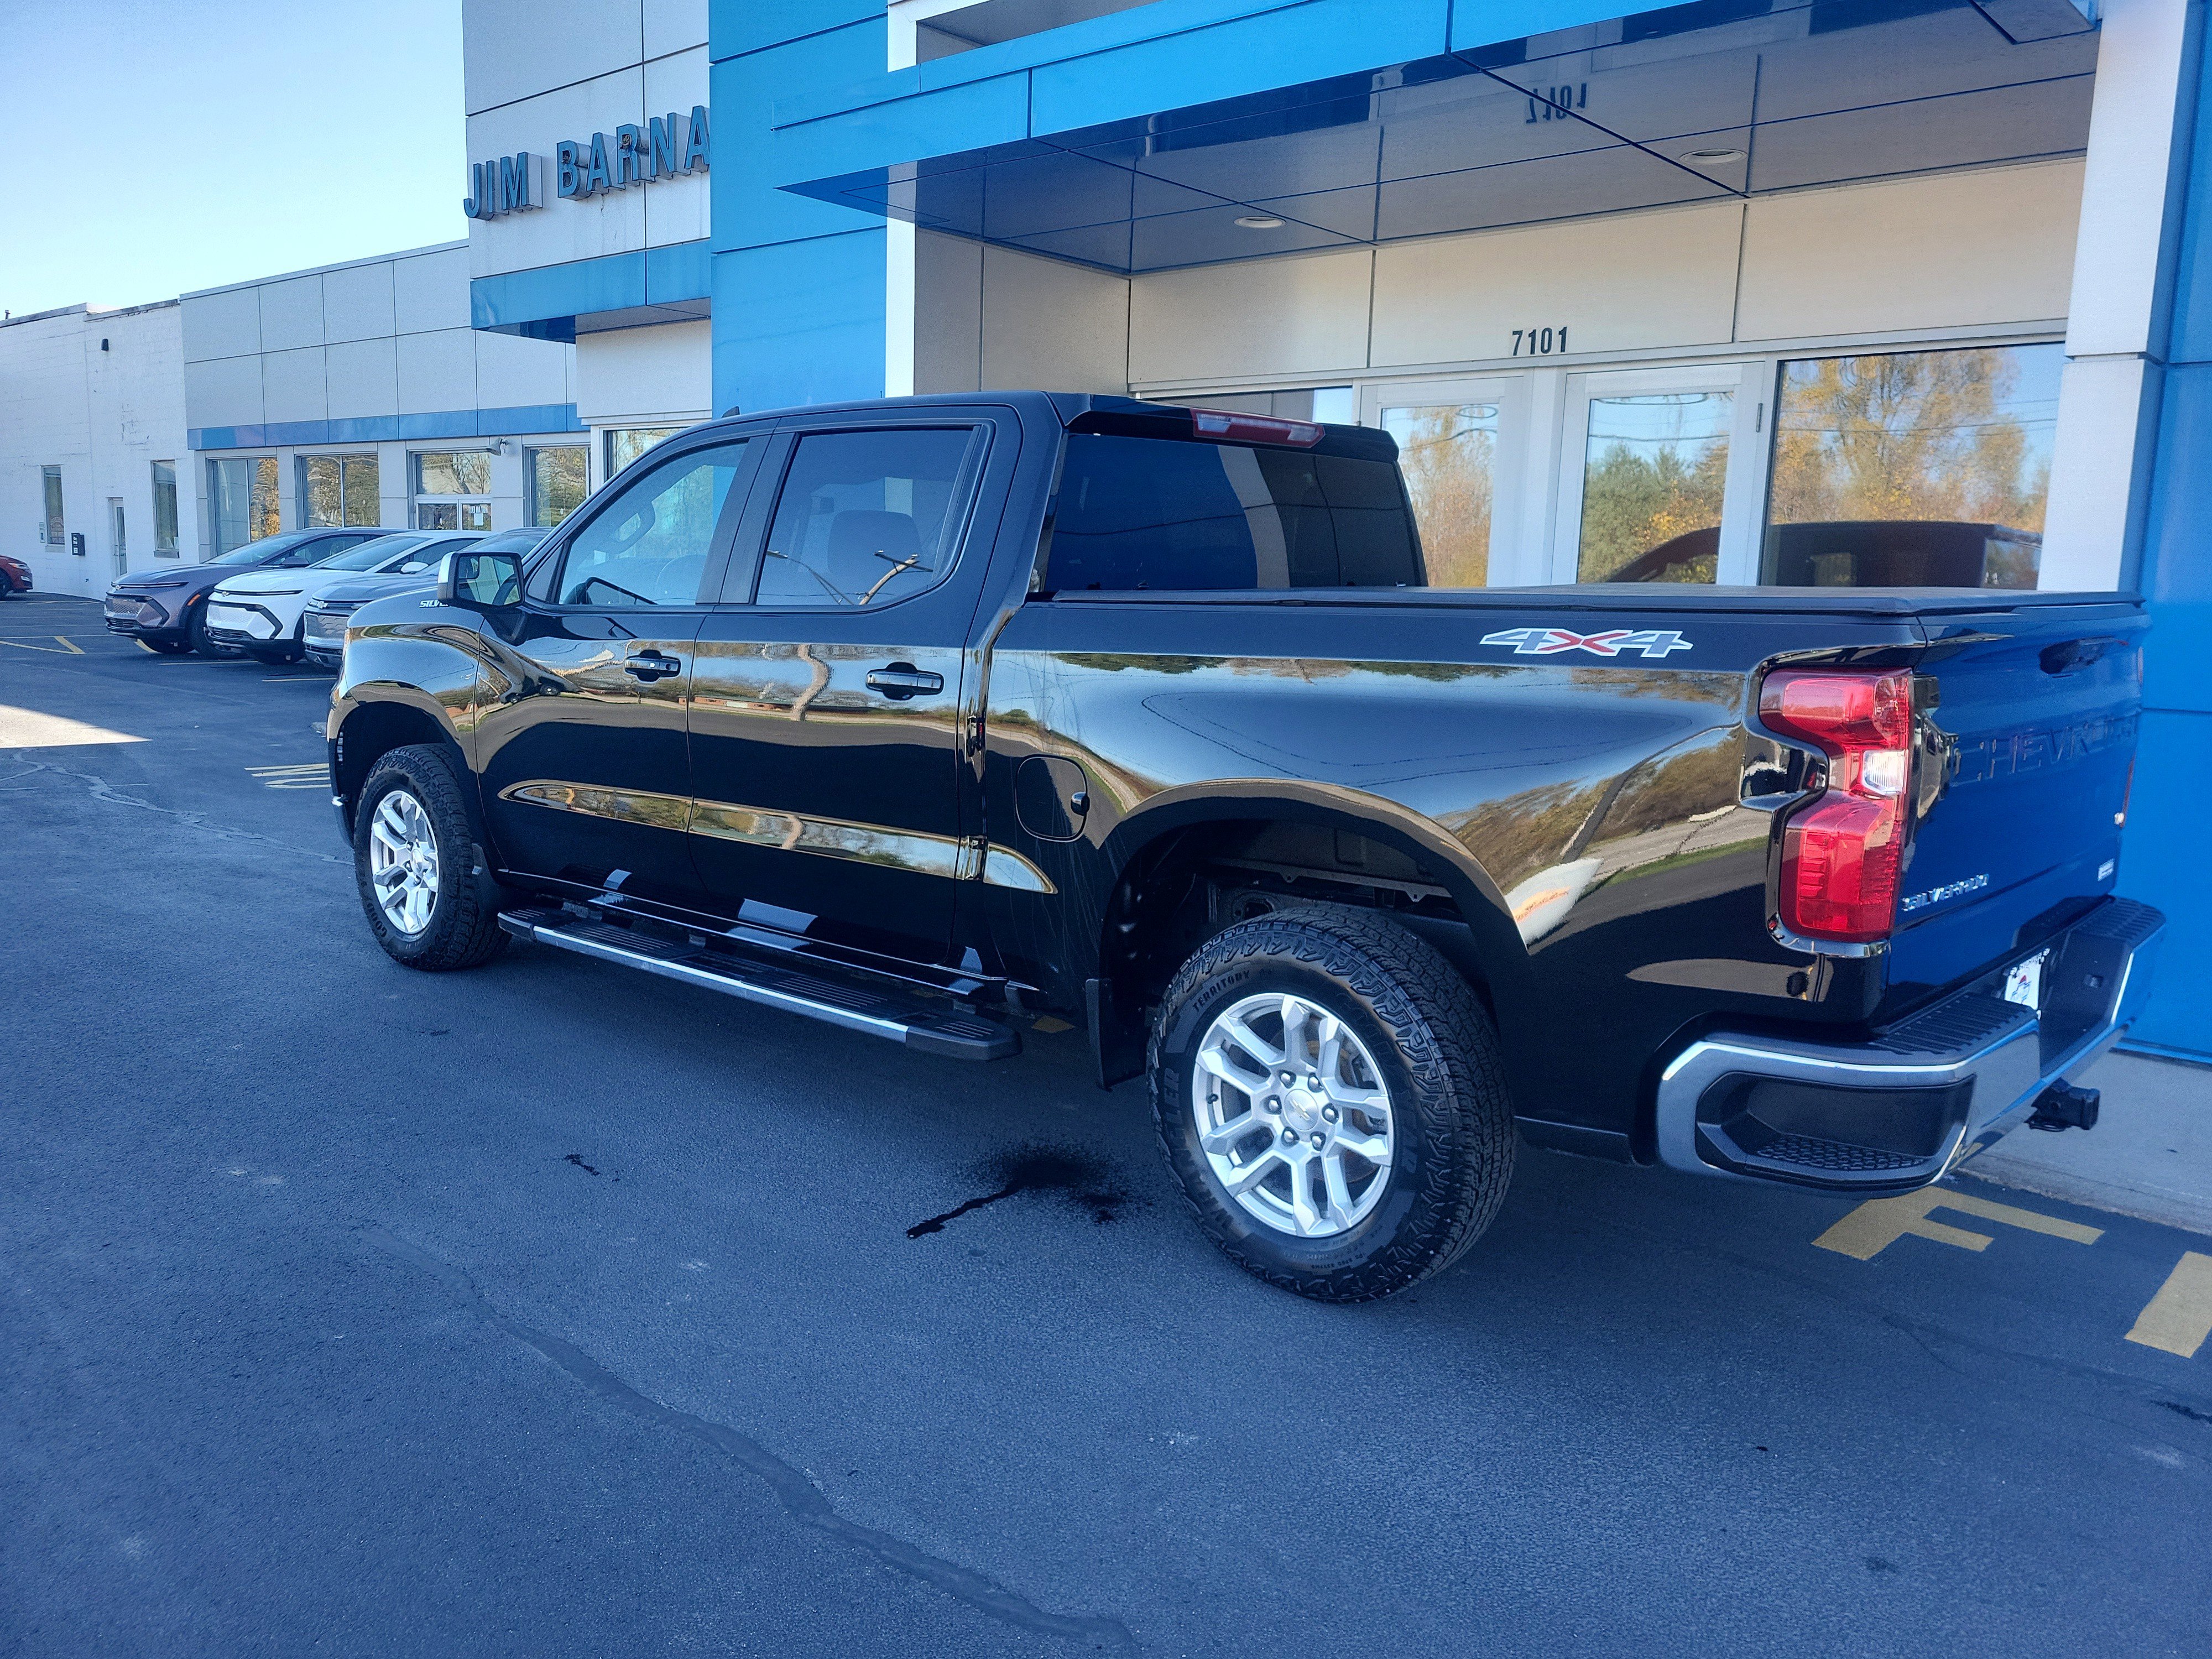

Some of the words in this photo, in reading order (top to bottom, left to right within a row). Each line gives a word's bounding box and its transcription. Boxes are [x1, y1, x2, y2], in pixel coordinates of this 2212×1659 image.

[463, 151, 534, 219] JIM
[556, 105, 711, 200] BARNA
[1512, 326, 1568, 357] 7101
[1192, 969, 1250, 1012] TERRITORY
